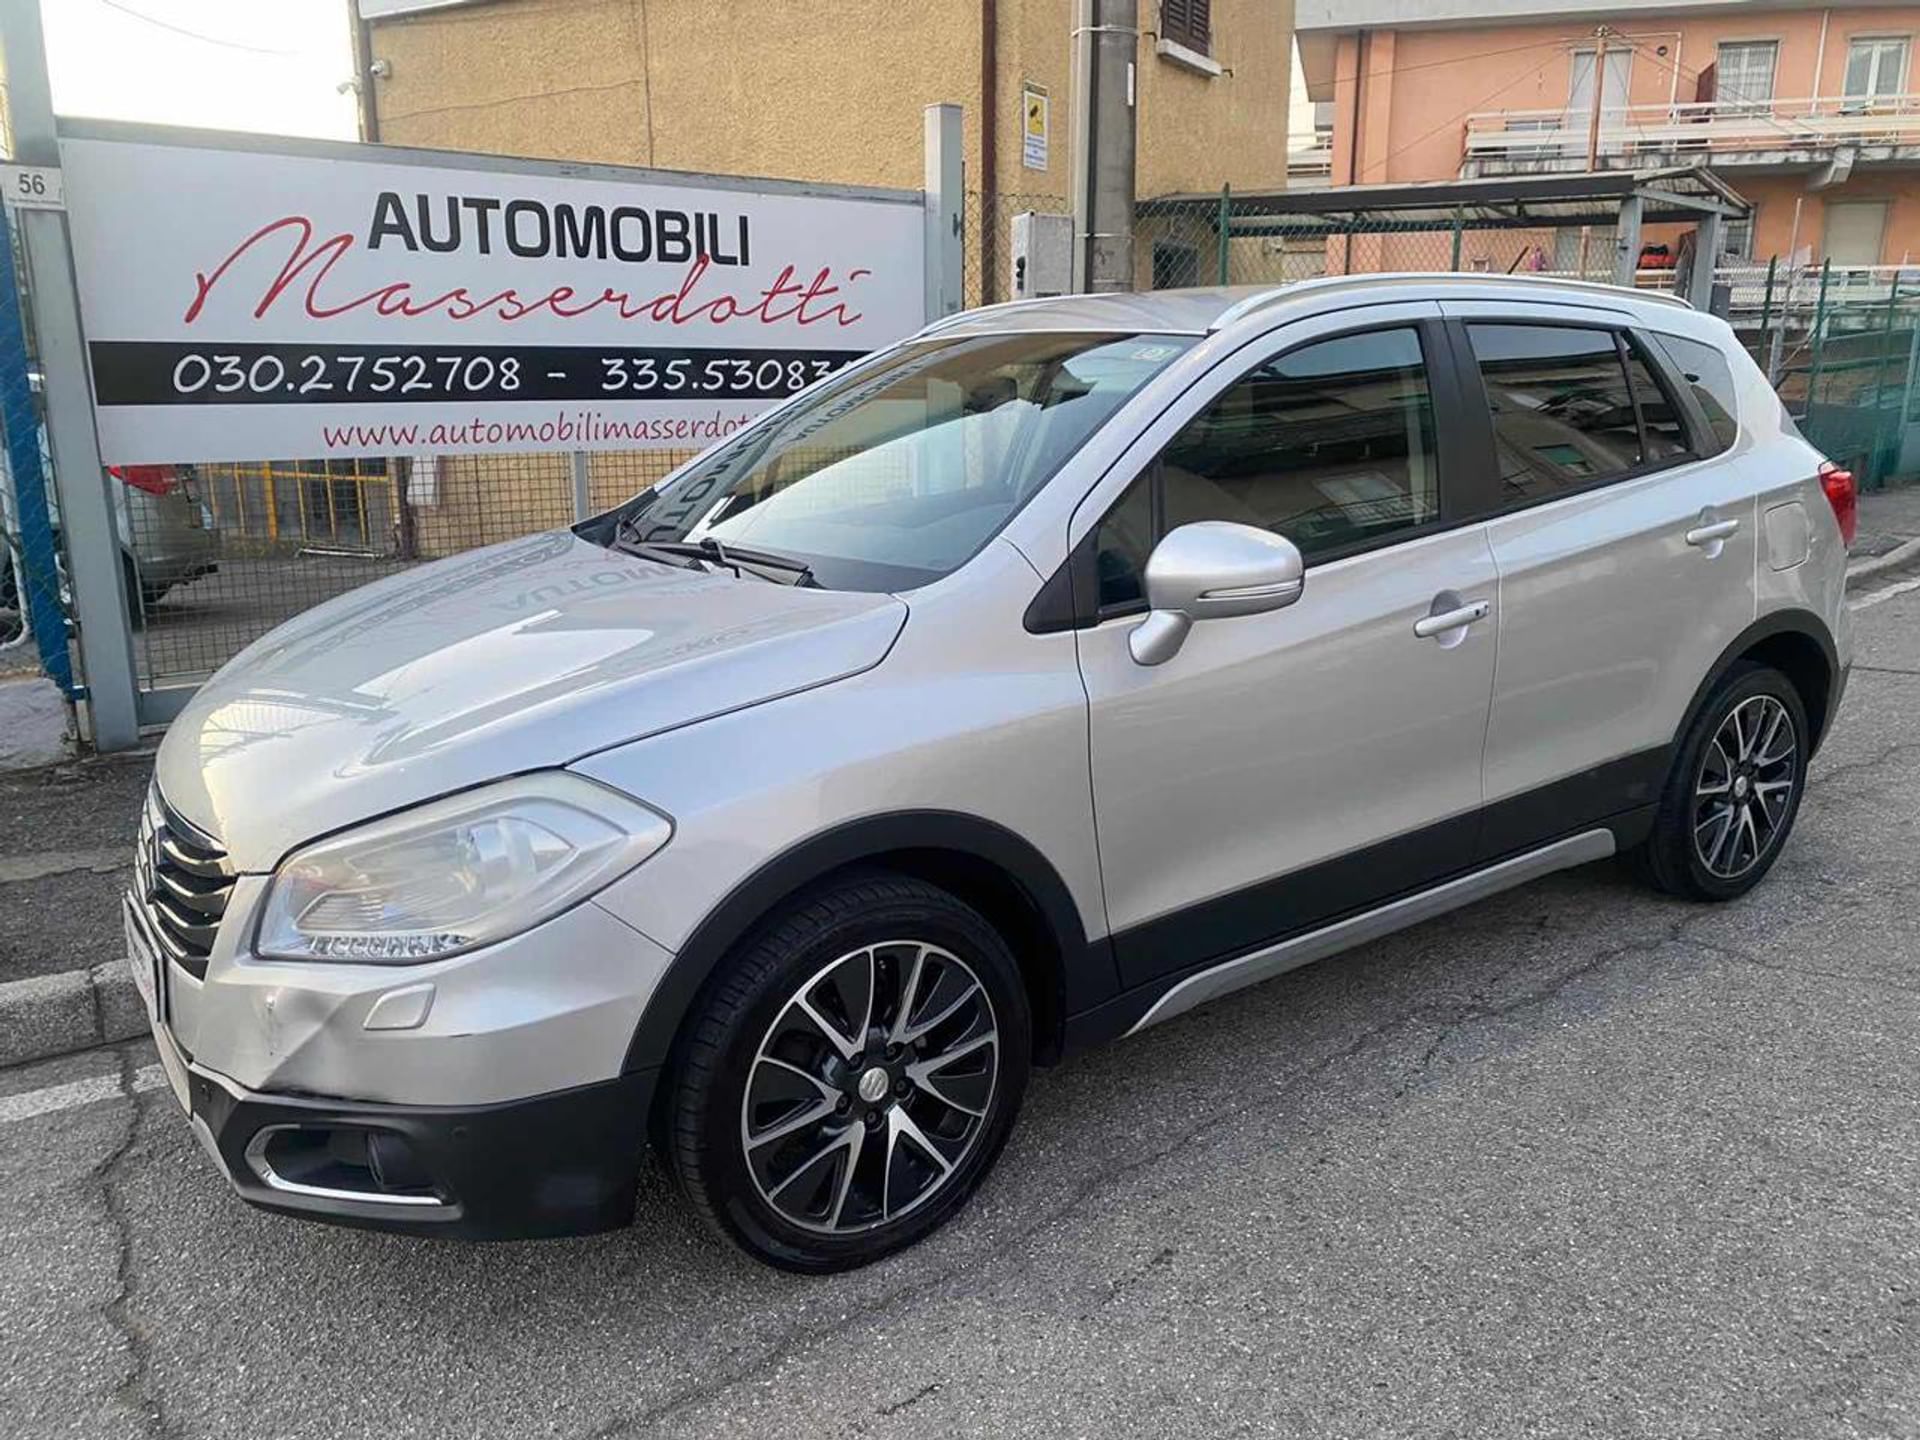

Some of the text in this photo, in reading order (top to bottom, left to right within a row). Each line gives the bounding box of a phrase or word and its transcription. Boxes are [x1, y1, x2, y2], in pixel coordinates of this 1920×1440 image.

[18, 173, 46, 195] 56
[368, 191, 750, 267] AUTOMOBILI
[184, 216, 872, 326] Masserdotti
[173, 355, 520, 394] 030.2752708
[601, 358, 853, 391] 335.53083
